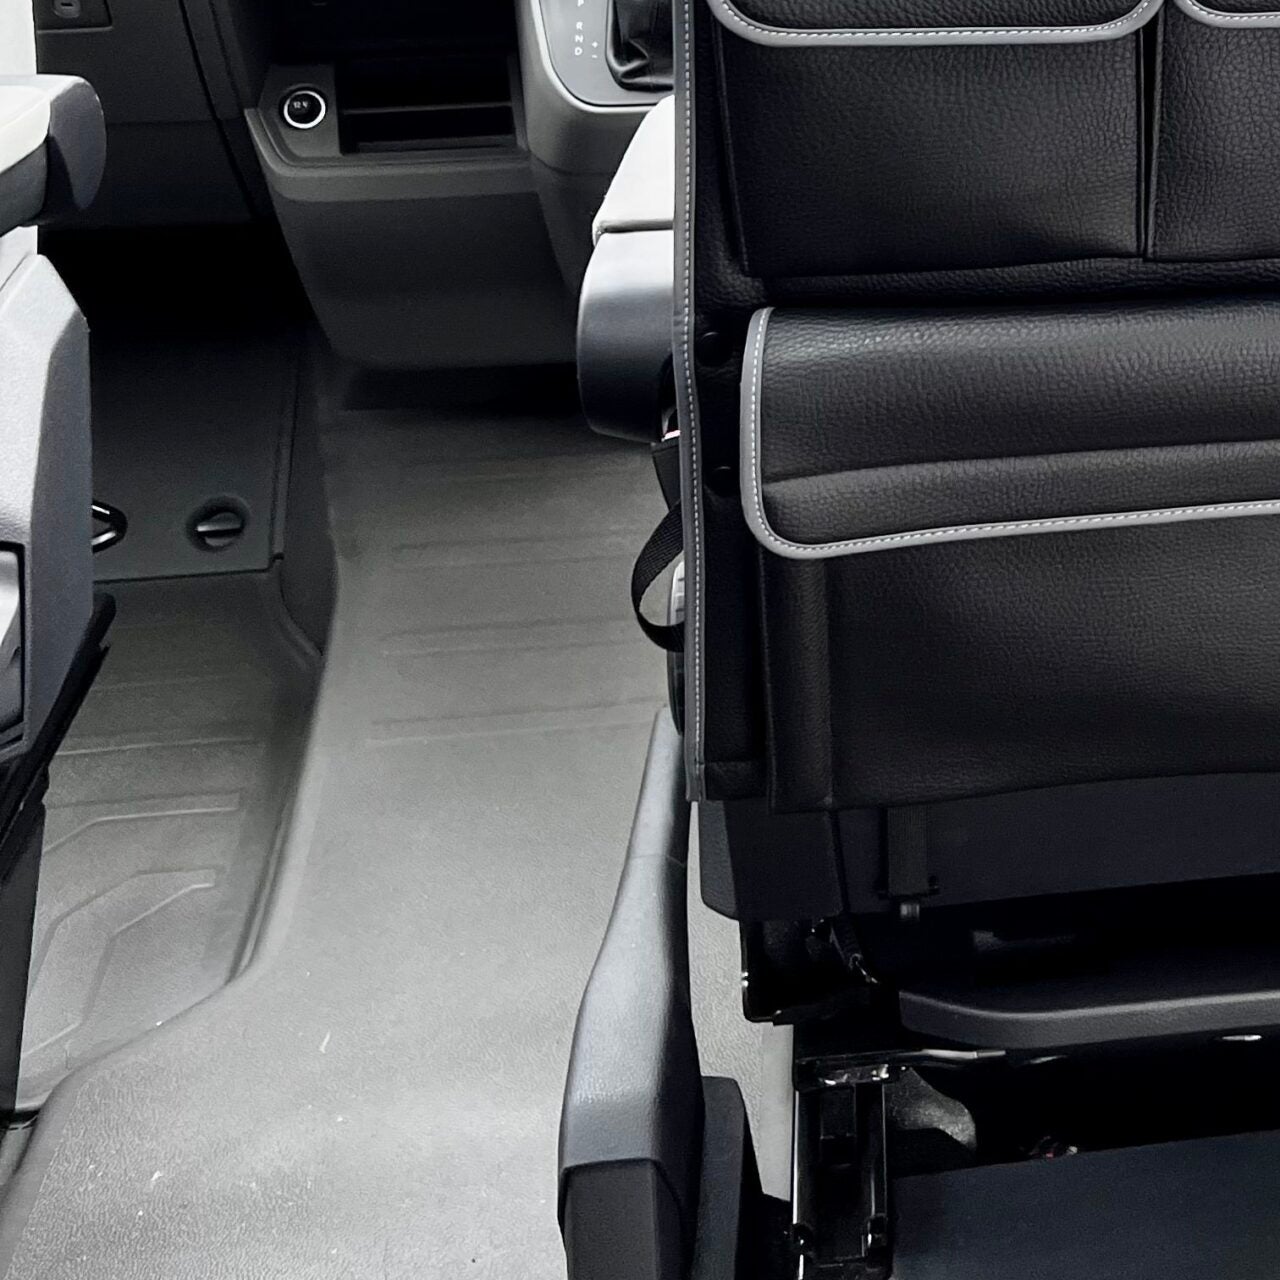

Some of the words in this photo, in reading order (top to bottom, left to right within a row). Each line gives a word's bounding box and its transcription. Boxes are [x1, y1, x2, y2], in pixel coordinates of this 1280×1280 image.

[575, 21, 584, 30] R
[575, 34, 584, 43] N
[574, 46, 583, 56] D
